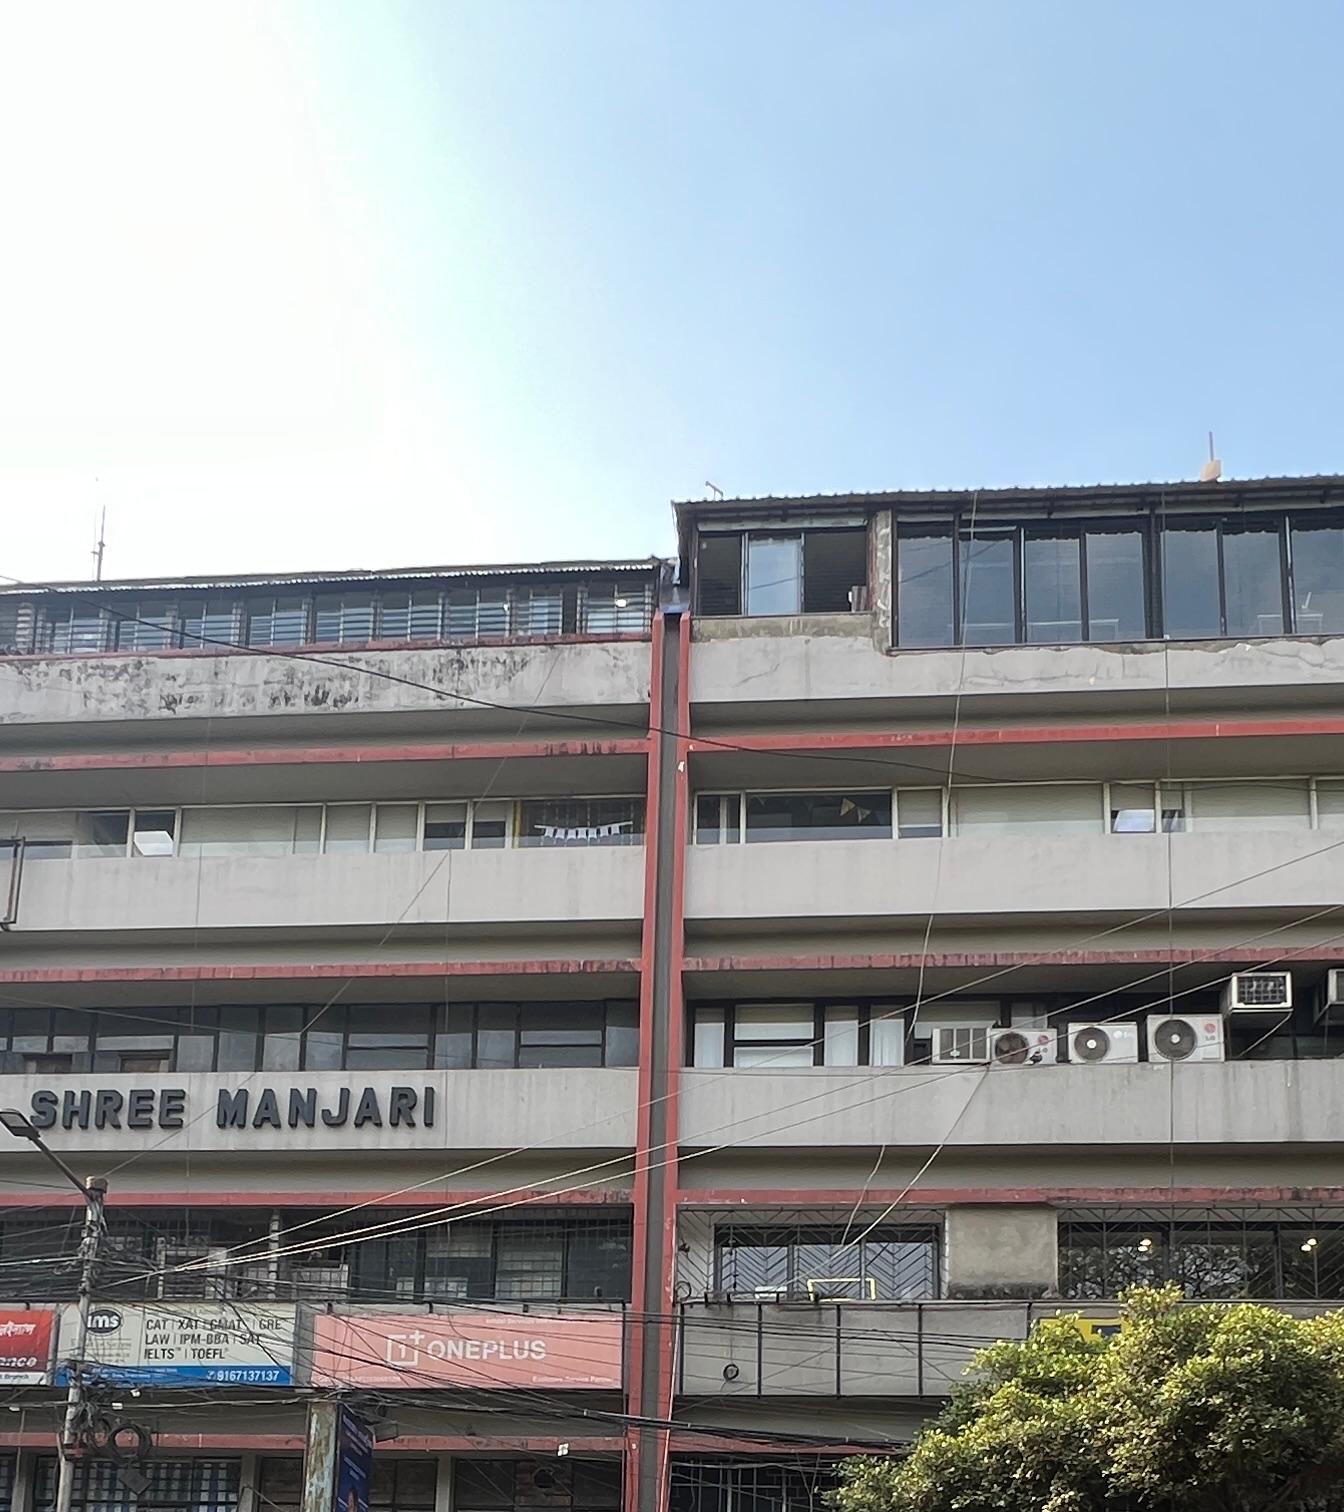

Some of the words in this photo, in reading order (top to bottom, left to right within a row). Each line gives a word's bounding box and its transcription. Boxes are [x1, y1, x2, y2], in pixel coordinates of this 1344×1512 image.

[30, 1088, 186, 1129] SHREE
[216, 1086, 435, 1129] MANJARI
[146, 1319, 168, 1331] CAT
[178, 1319, 199, 1330] XAT
[259, 1319, 282, 1330] GRE
[145, 1334, 170, 1345] LAW
[180, 1334, 229, 1345] IPM-BBA
[239, 1334, 261, 1345] SAT
[427, 1339, 547, 1361] ONEPLUS
[217, 1370, 280, 1382] 9167137137
